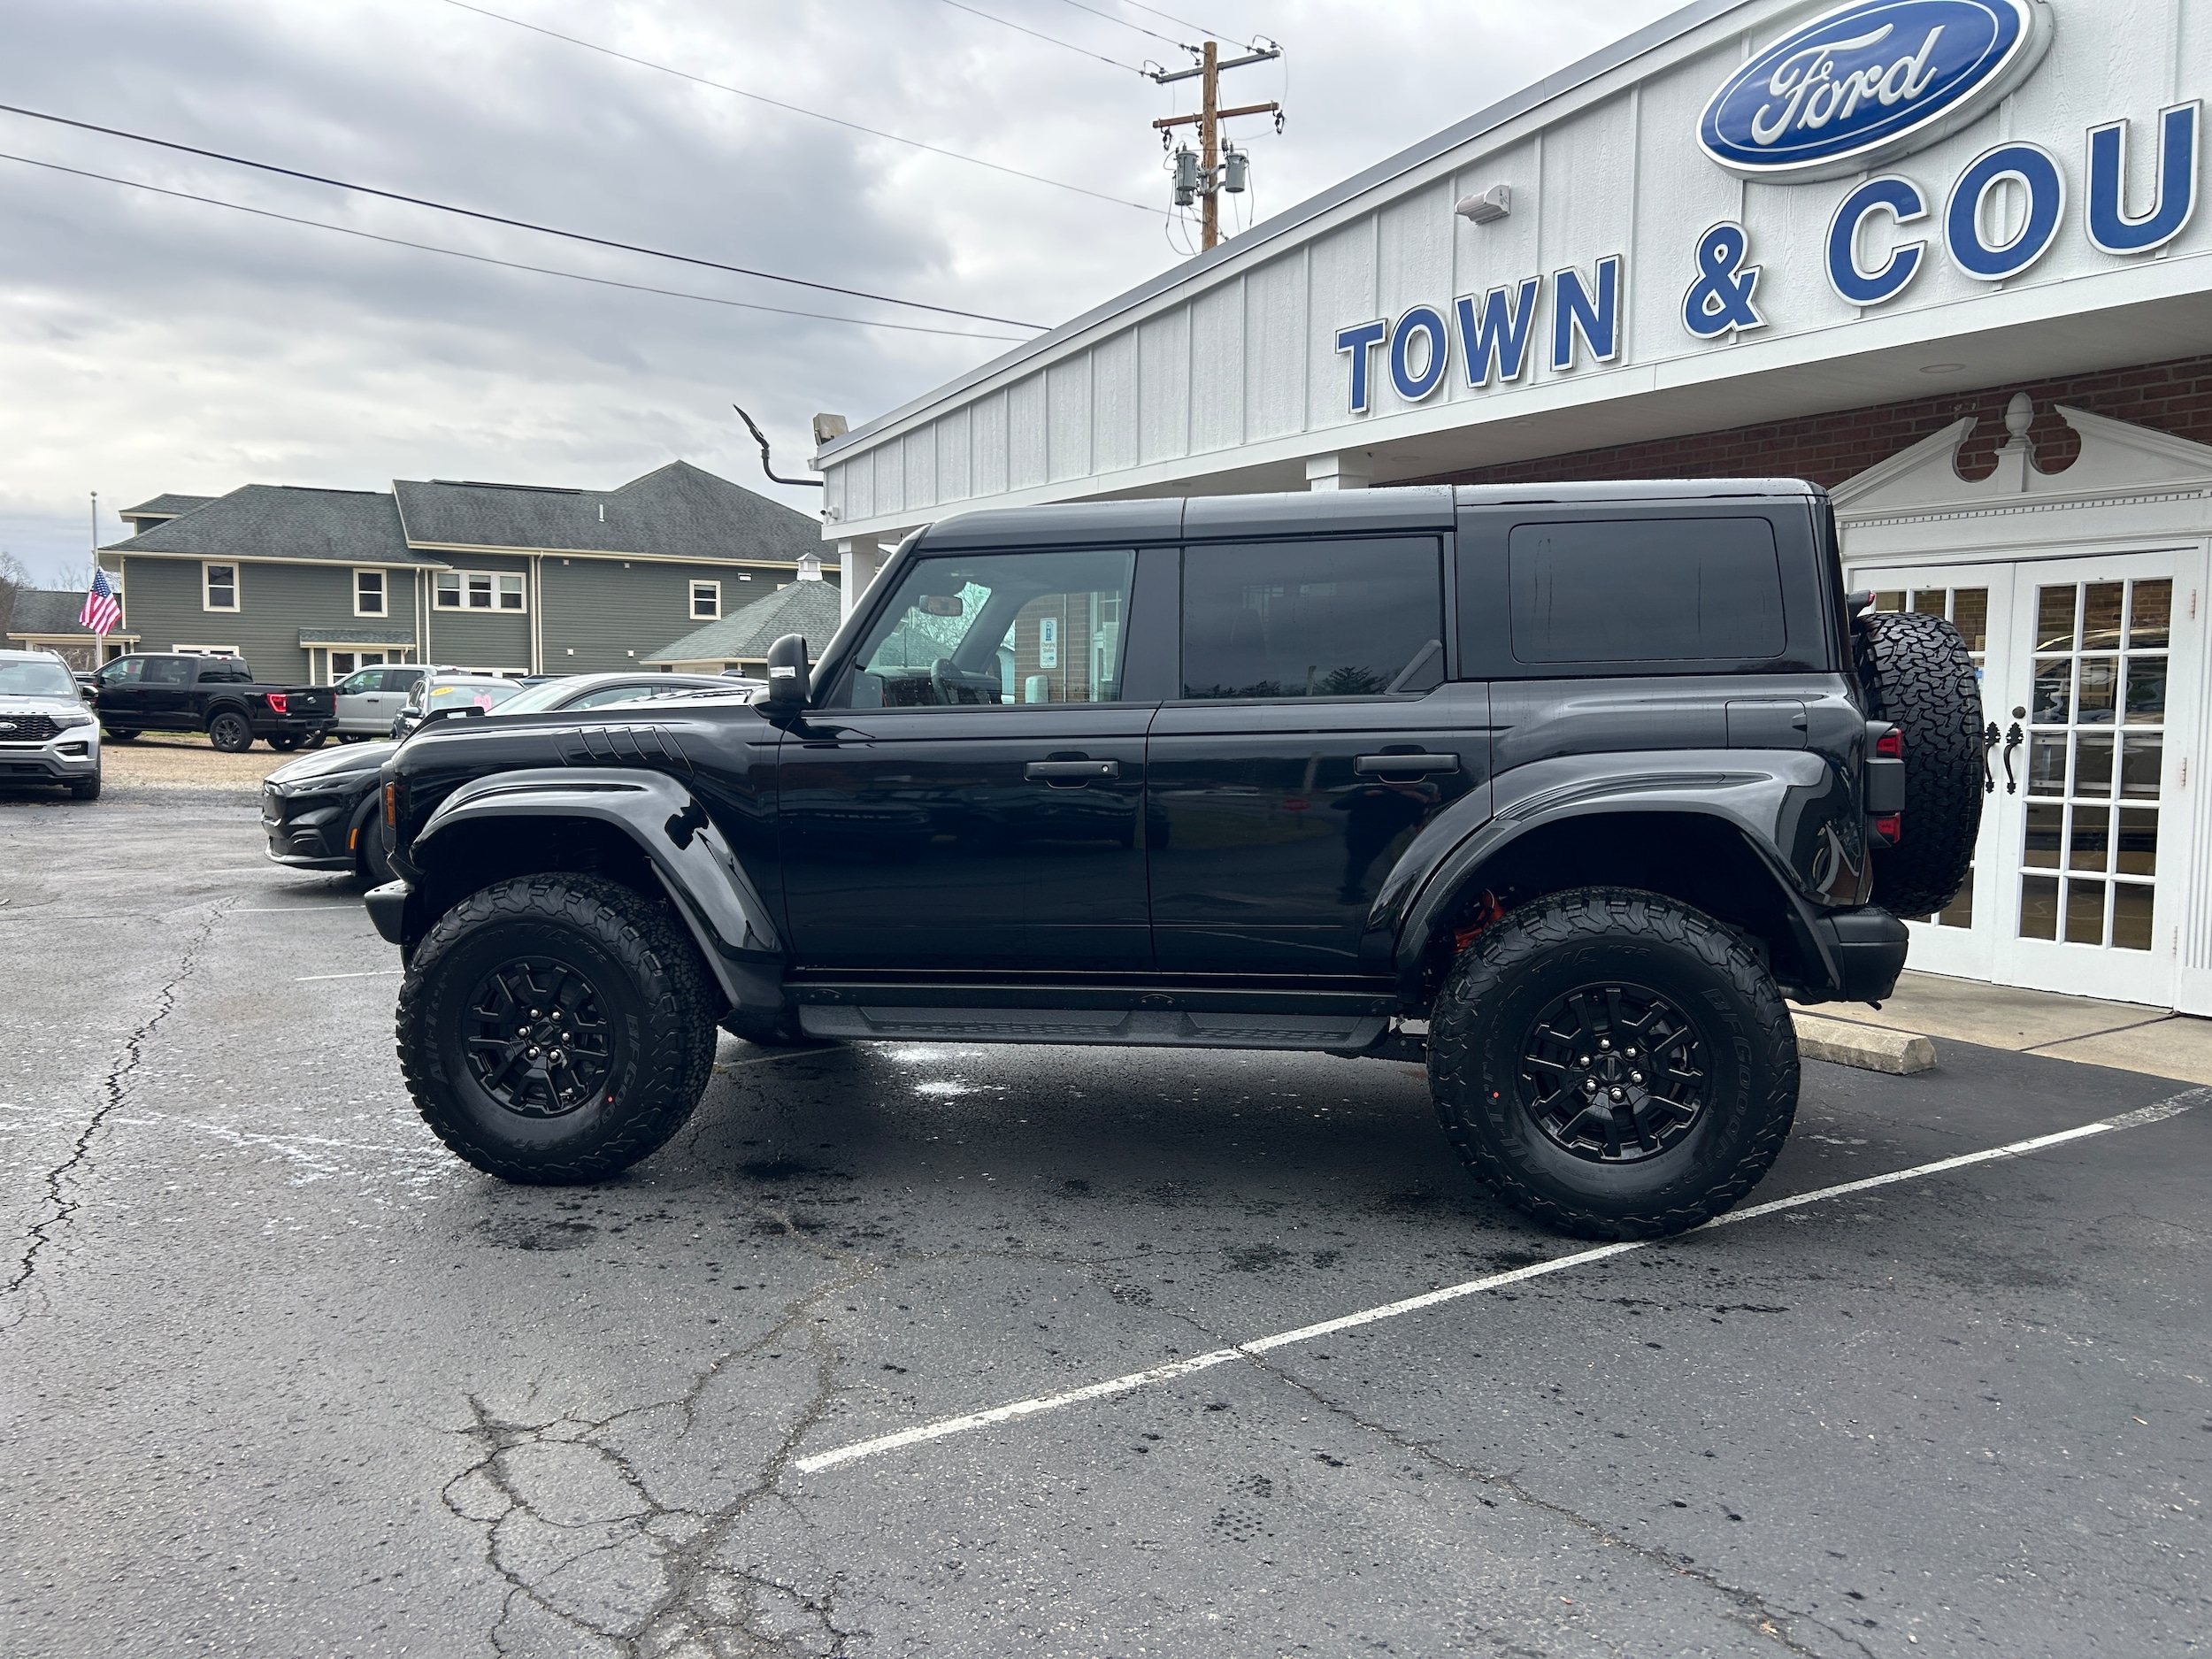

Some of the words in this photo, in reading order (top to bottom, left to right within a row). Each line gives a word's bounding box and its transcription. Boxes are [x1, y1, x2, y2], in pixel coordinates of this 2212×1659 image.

[1751, 23, 1946, 146] Ford
[1335, 254, 1623, 414] TOWN
[1681, 220, 1765, 340] &
[1824, 99, 2202, 307] COU
